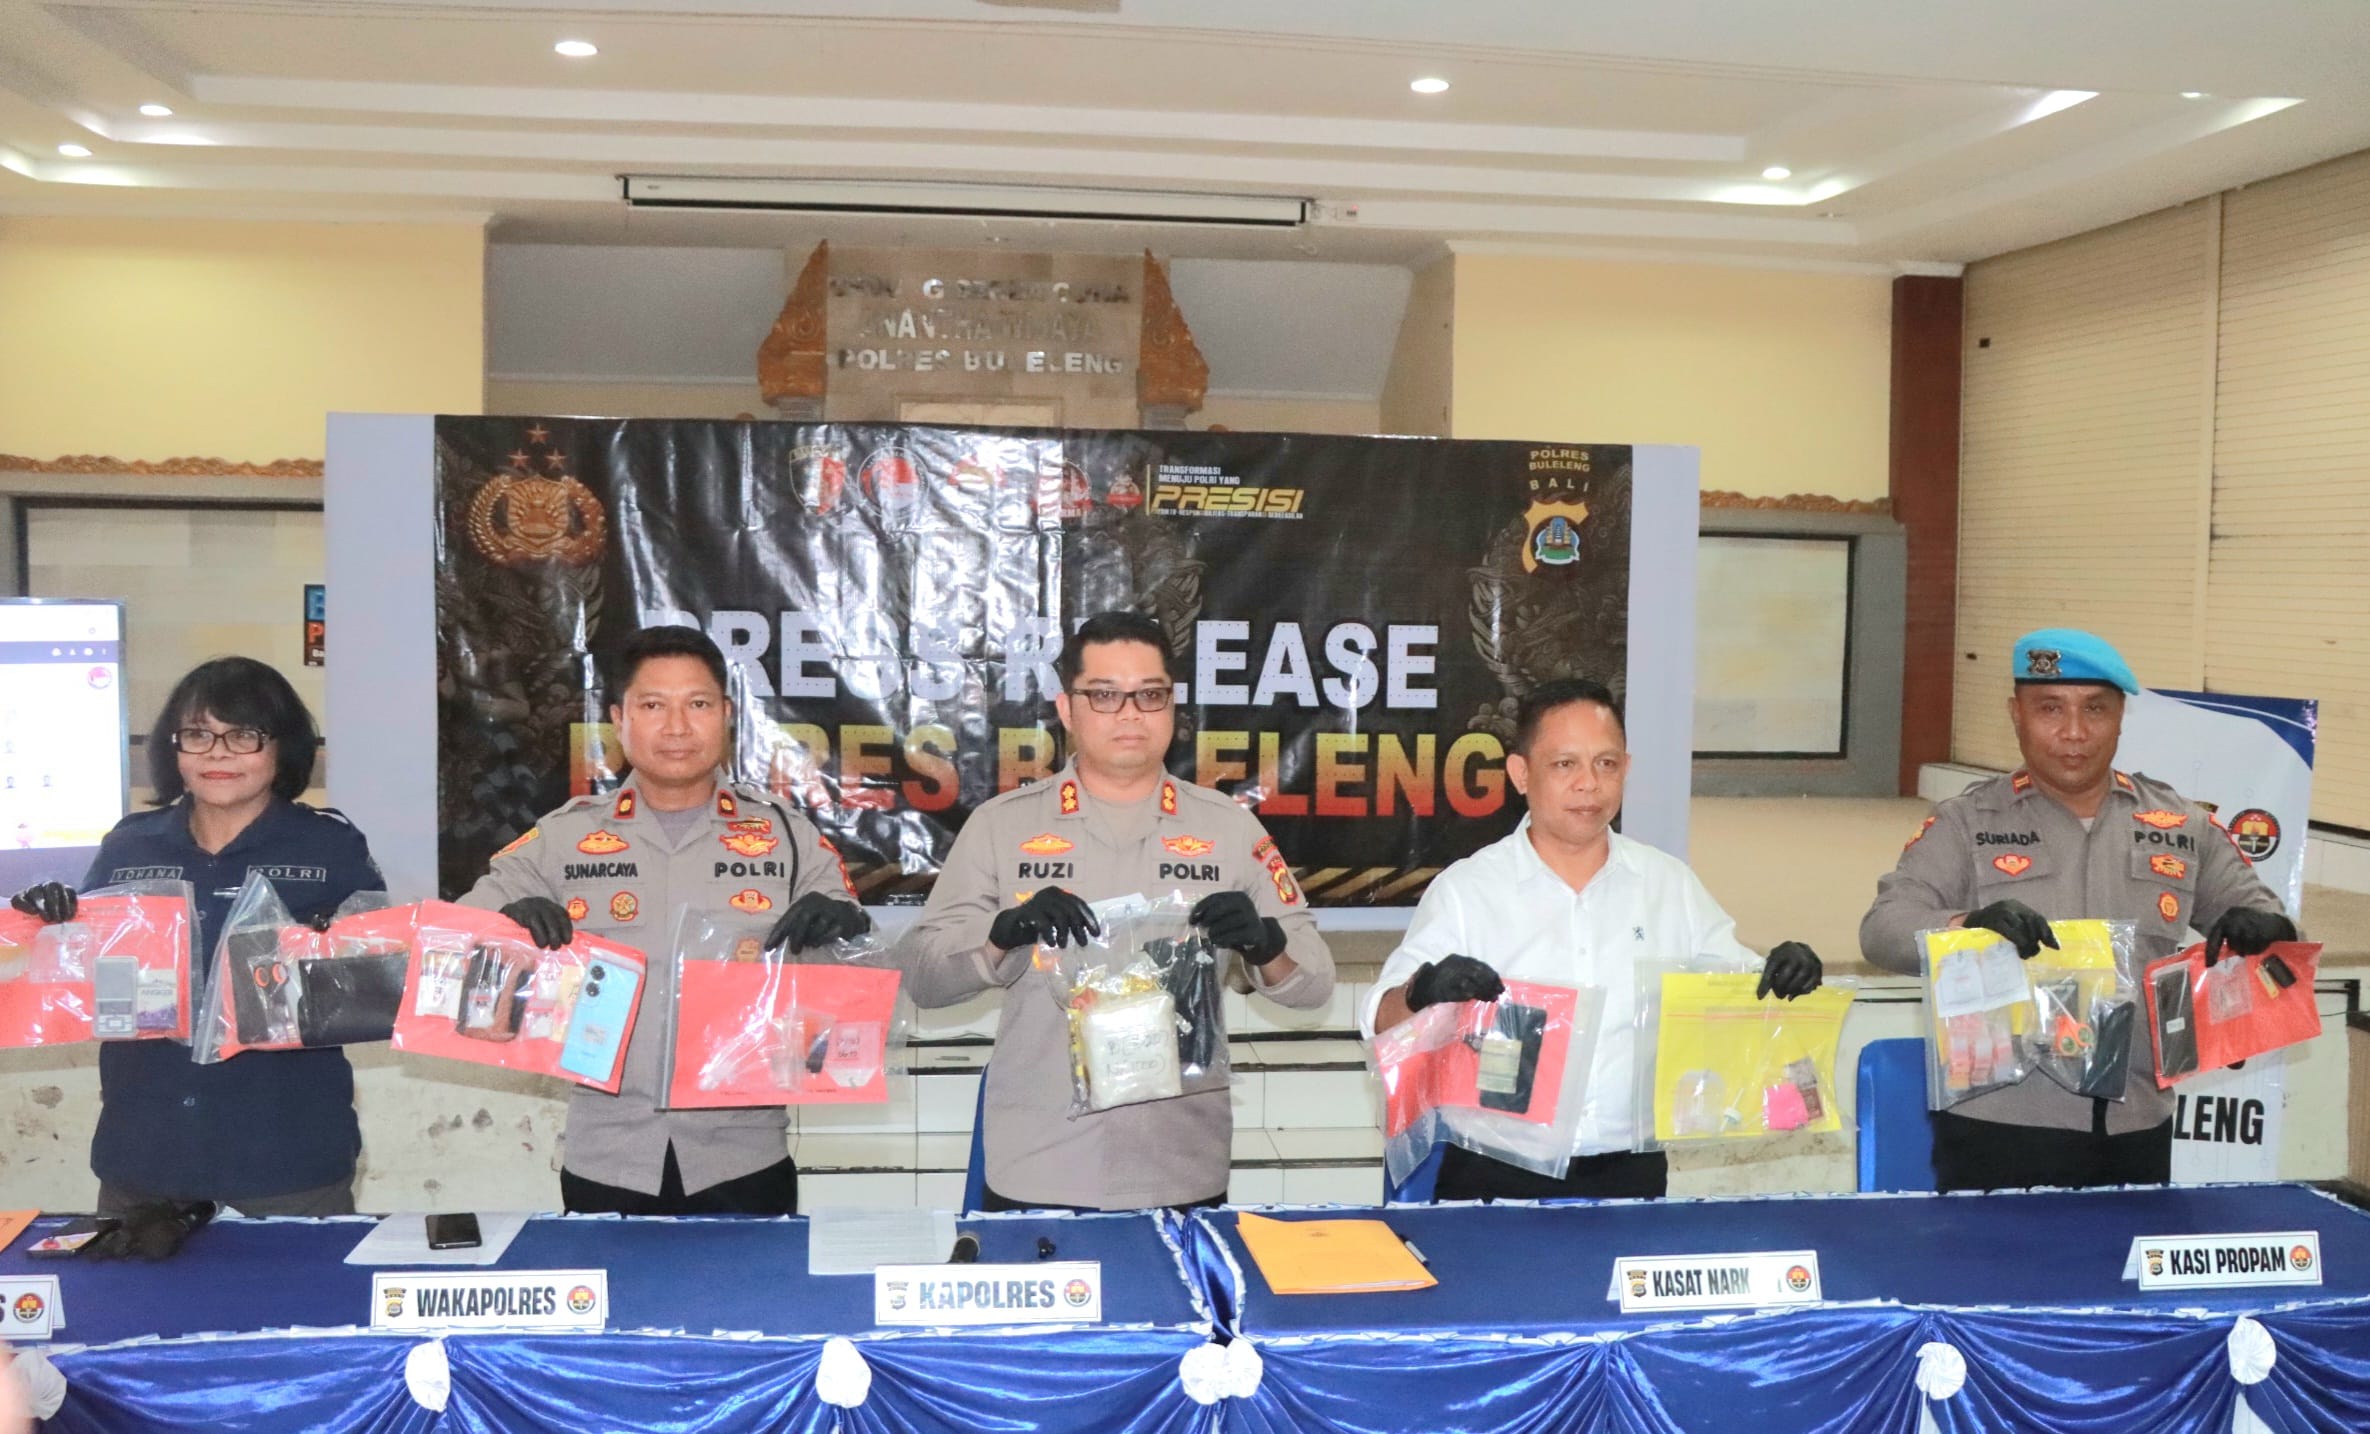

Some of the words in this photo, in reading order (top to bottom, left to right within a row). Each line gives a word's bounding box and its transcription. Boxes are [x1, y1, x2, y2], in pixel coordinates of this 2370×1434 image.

[1530, 449, 1589, 461] POLRES
[1159, 465, 1221, 475] TRANSFORMASI
[1529, 460, 1590, 472] BULELENG
[1159, 474, 1193, 484] MENUJU
[1194, 476, 1217, 484] POLRI
[1218, 476, 1240, 486] YANG
[1529, 477, 1589, 492] BALI
[1151, 485, 1304, 513] PRESISI
[1003, 616, 1440, 709] REASE
[999, 727, 1507, 818] BELENG
[1975, 831, 2041, 846] SURIADA
[2134, 830, 2195, 852] POLRI
[564, 862, 639, 880] SUNARCAYA
[714, 861, 785, 878] POLRI
[1018, 862, 1073, 879] RUZI
[1158, 863, 1220, 882] POLRI
[2170, 1249, 2211, 1275] KASI
[2215, 1246, 2287, 1273] PROPAM
[1653, 1269, 1702, 1297] KASAT
[416, 1286, 557, 1318] WAKAPOLRES
[919, 1280, 1056, 1310] KAPOLRES
